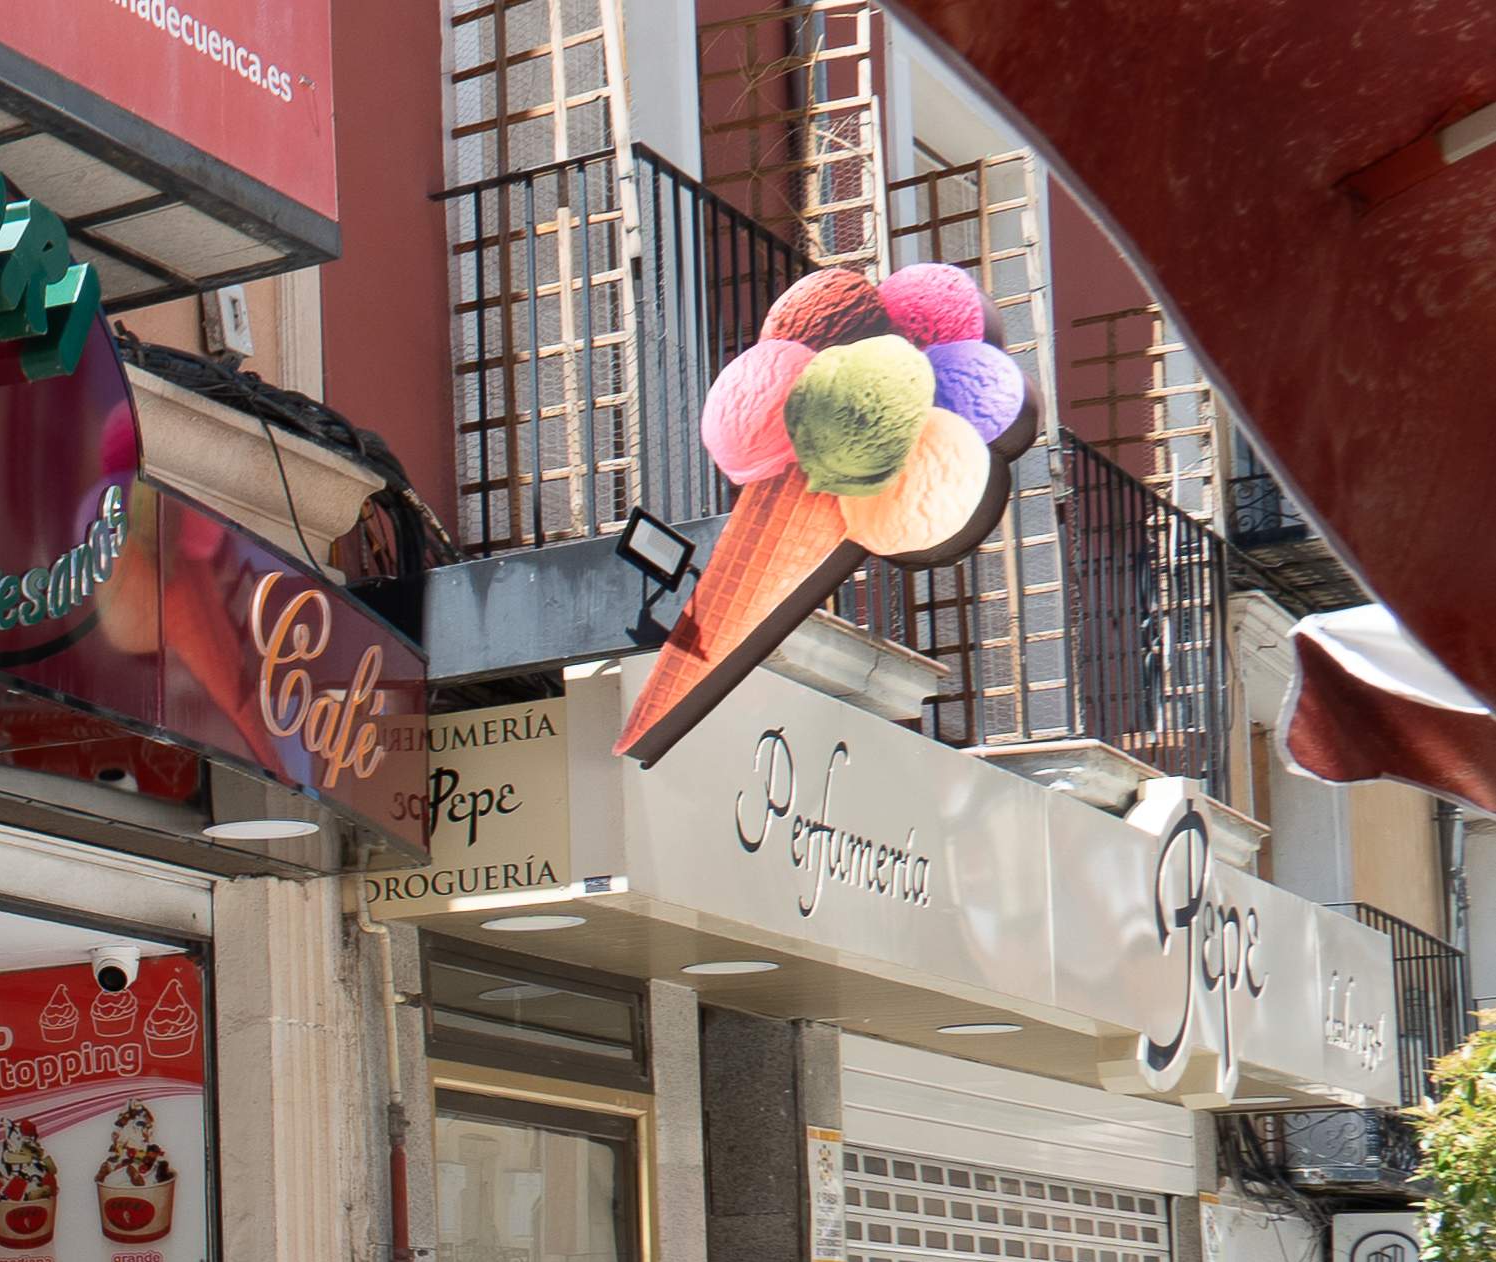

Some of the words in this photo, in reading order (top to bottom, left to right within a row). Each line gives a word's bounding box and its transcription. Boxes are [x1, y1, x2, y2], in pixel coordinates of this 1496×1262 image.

[117, 0, 293, 102] nadecuenca.es
[252, 571, 384, 788] Café
[428, 709, 559, 752] UMERÍA
[429, 767, 523, 847] Pepe
[736, 727, 931, 918] Perfumería
[1138, 799, 1269, 1095] Pepe
